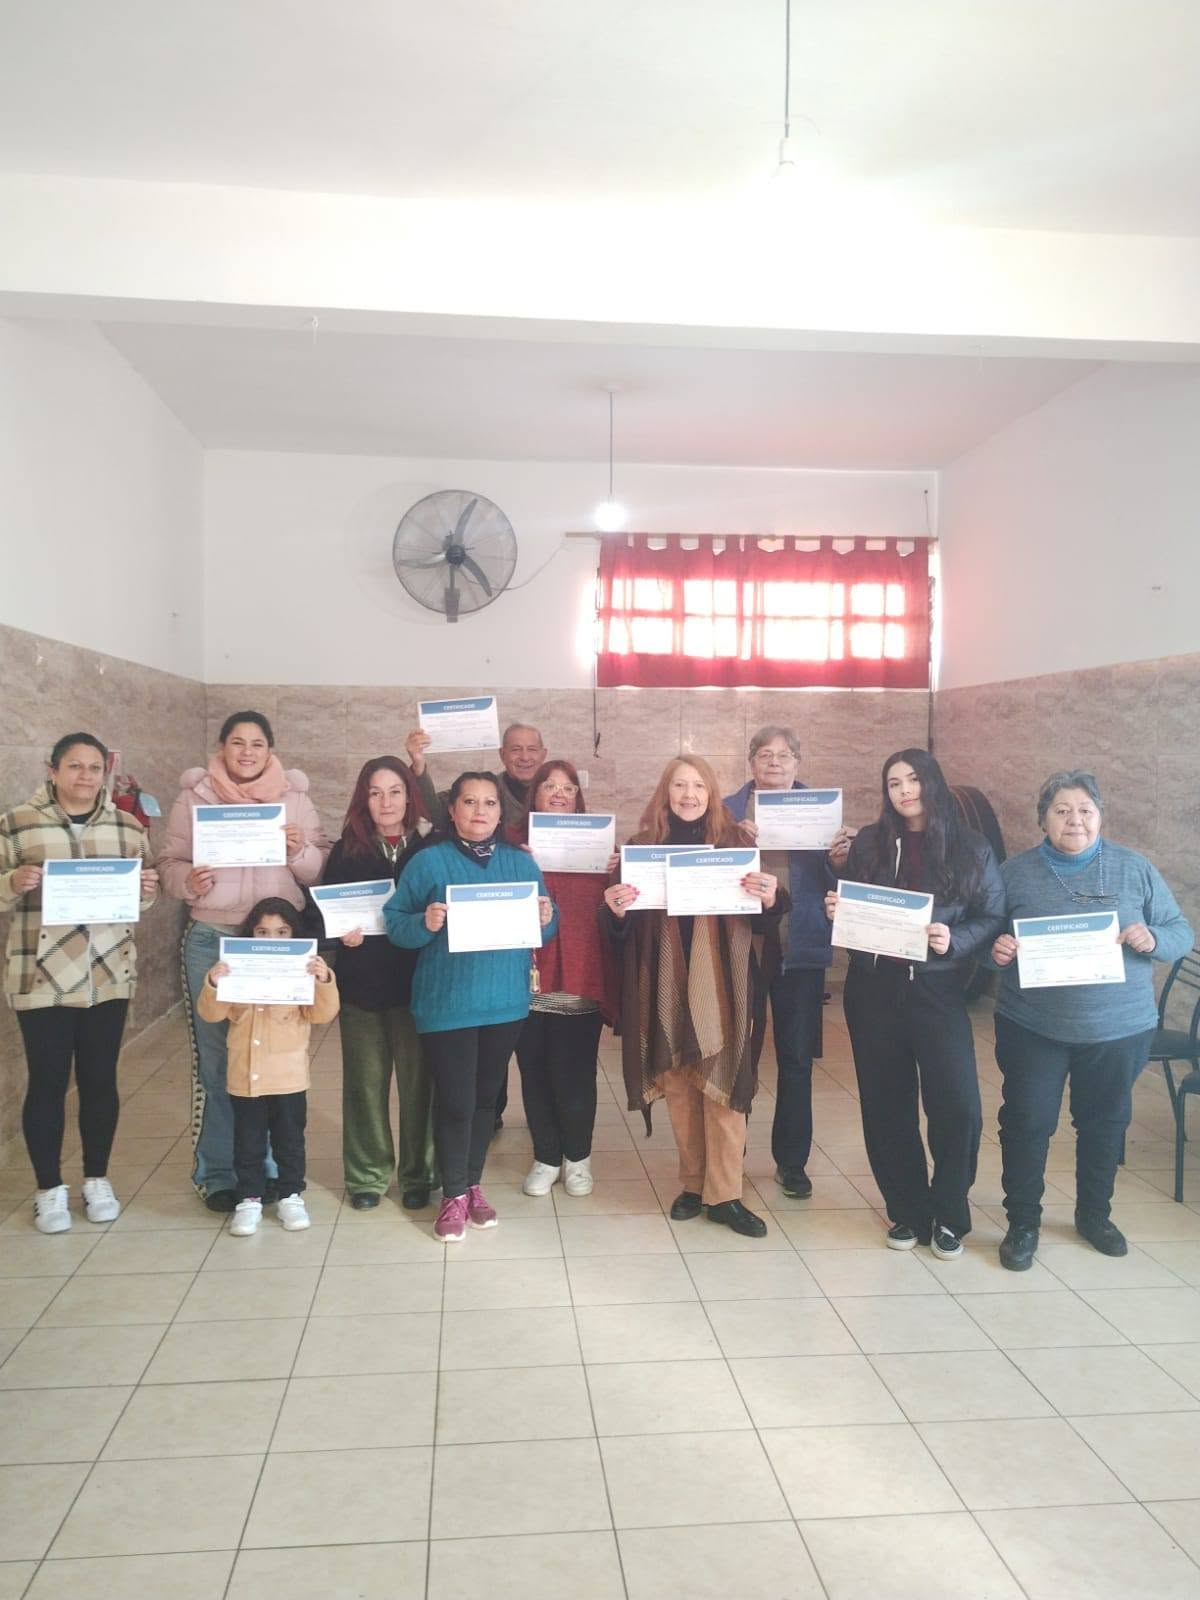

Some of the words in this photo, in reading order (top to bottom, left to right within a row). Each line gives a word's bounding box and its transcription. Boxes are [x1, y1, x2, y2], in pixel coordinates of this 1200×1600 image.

[443, 703, 476, 711] CERTIFICADO
[867, 893, 905, 904] CERTIFICADO
[1047, 922, 1089, 931] CERTIFICADO
